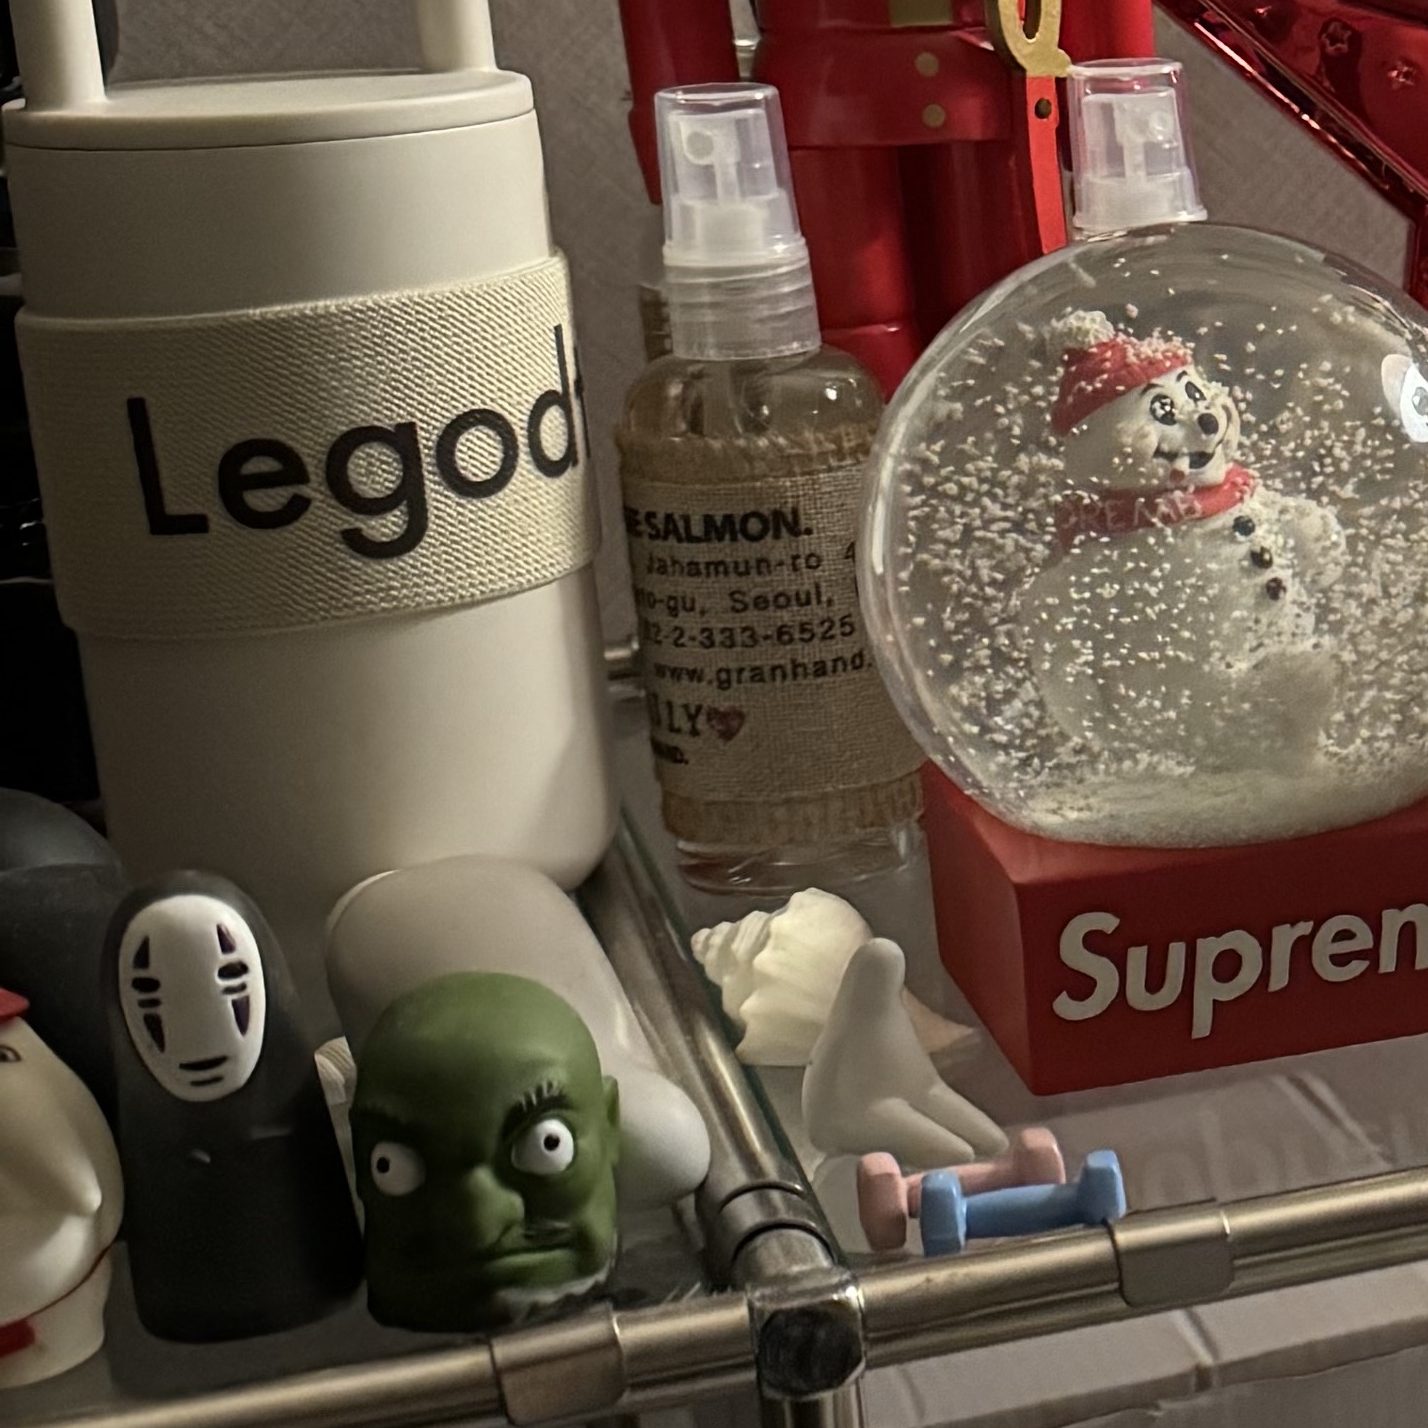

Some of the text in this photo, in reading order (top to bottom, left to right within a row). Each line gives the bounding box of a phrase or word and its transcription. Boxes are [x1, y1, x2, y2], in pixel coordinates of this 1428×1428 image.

[127, 324, 592, 559] Legod
[729, 583, 834, 613] Seoul,
[645, 613, 855, 648] 2-2-333-6525
